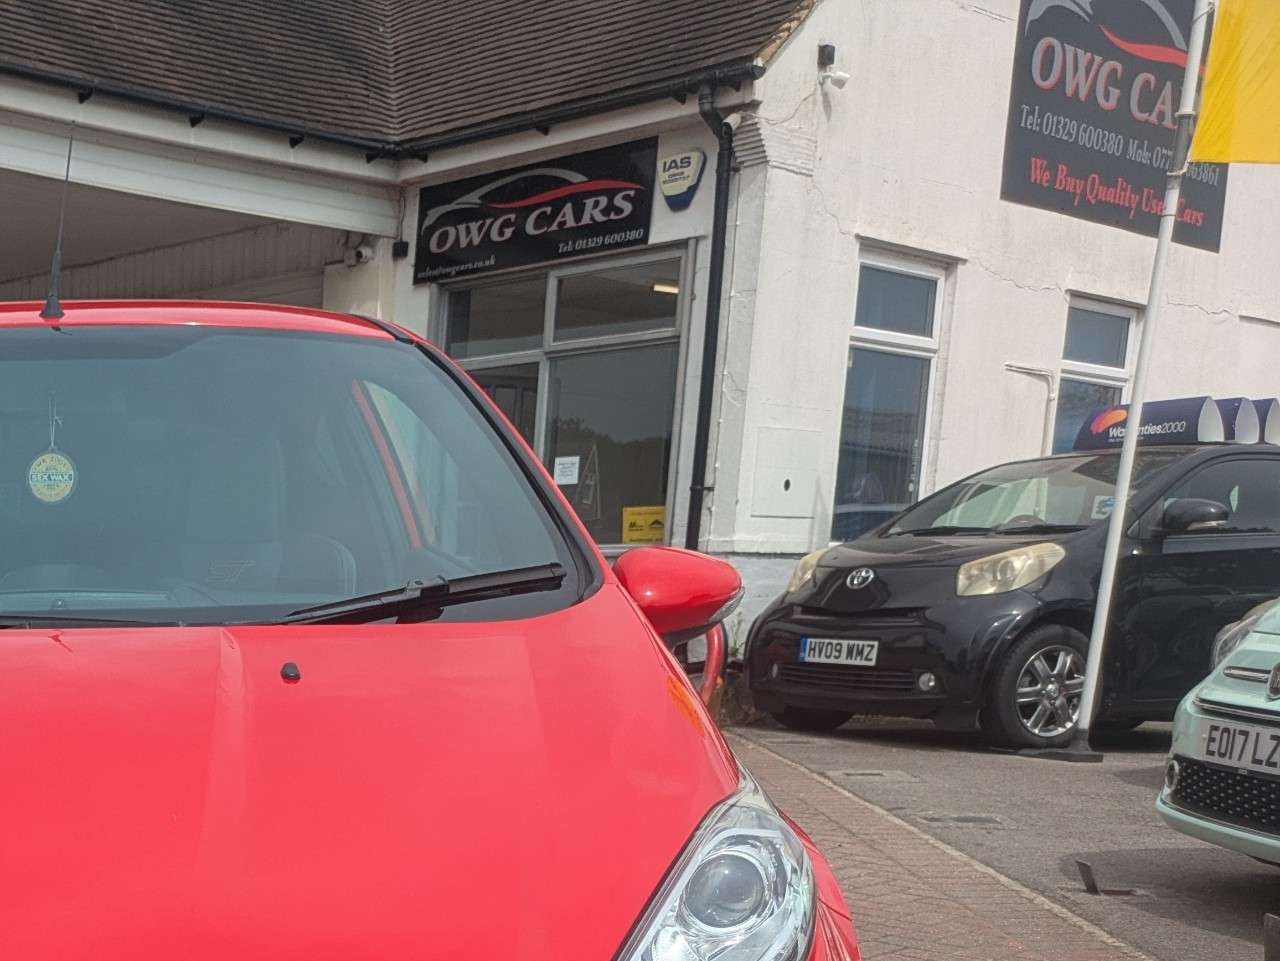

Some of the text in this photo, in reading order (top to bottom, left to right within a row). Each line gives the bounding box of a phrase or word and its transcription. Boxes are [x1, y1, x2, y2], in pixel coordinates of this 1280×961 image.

[1032, 36, 1178, 129] OWG CA
[1020, 104, 1040, 131] Tel:
[1042, 112, 1077, 142] 01329
[1078, 124, 1124, 156] 600380
[1126, 138, 1151, 165] Mob:
[662, 156, 692, 173] IAS
[1030, 157, 1205, 227] We Buy Quality Use Cars
[429, 189, 637, 253] OWG CARS
[575, 236, 603, 250] 01329
[604, 229, 645, 246] 600380
[807, 640, 875, 662] HV09 WMZ
[1251, 732, 1280, 768] LZ
